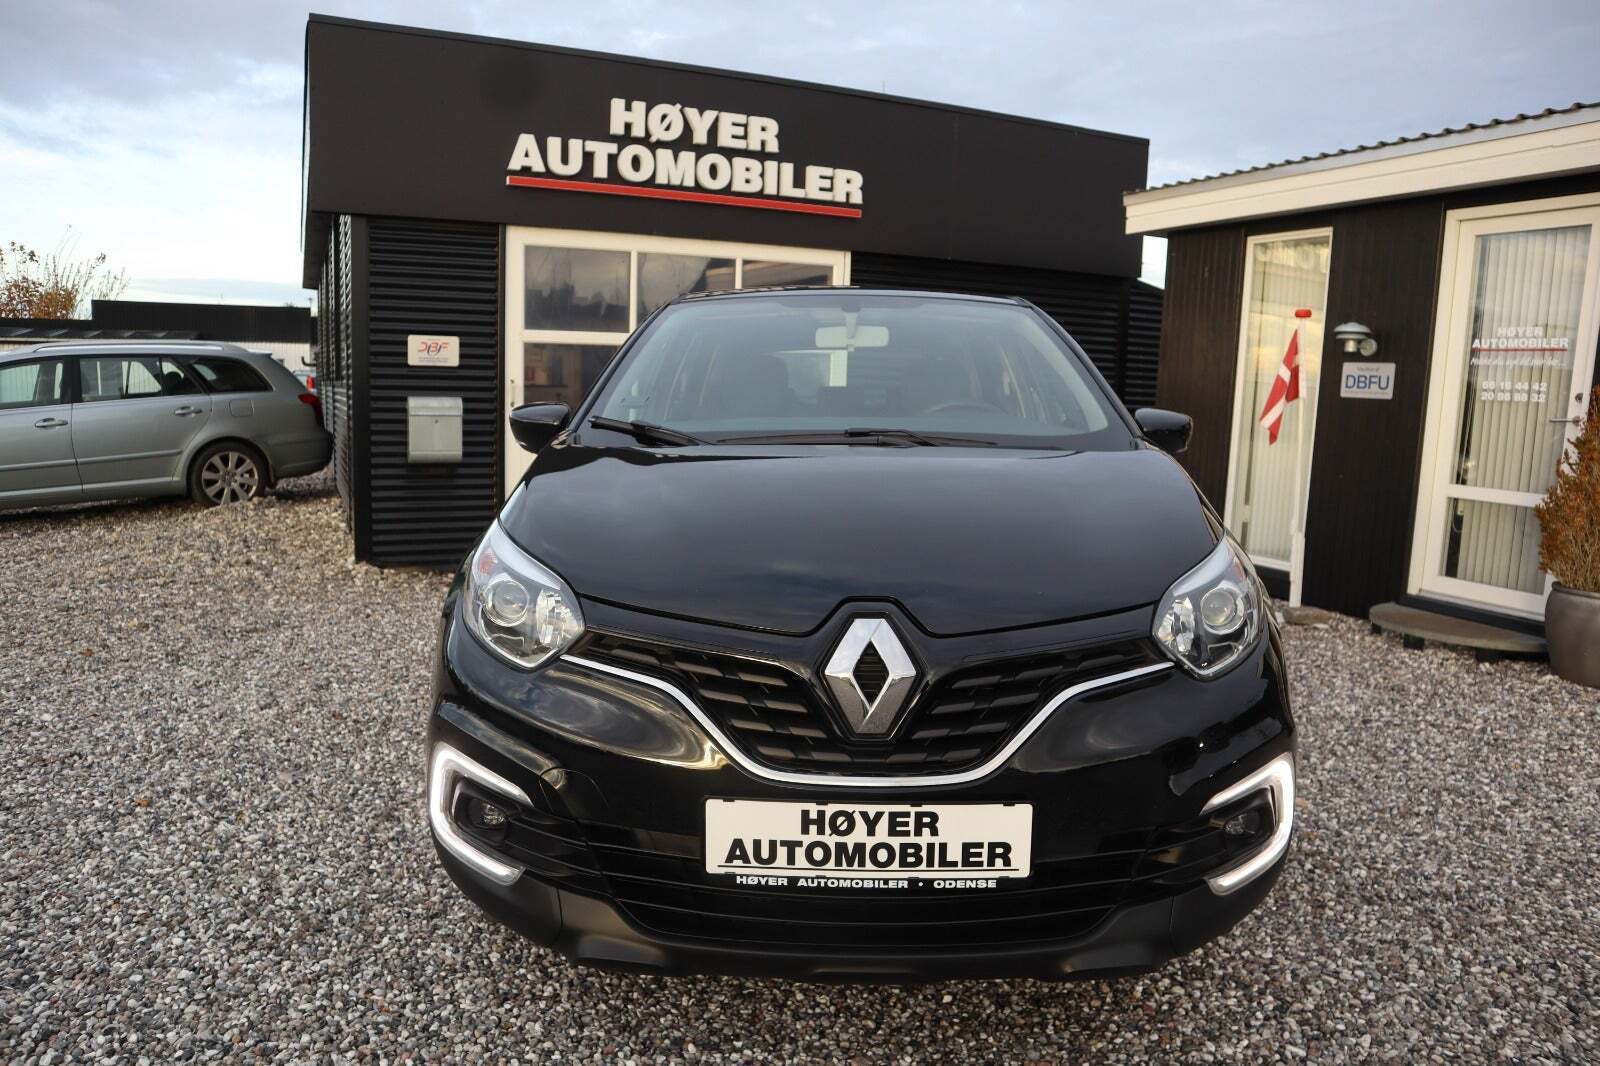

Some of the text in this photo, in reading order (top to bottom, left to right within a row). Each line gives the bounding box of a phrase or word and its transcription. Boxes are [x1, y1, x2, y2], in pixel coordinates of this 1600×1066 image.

[609, 97, 780, 153] HØYER
[506, 133, 864, 204] AUTOMOBILER
[1472, 338, 1569, 348] AUTOMOBILER
[1345, 374, 1390, 390] DBFU
[800, 809, 940, 837] HØYER
[724, 838, 1012, 868] AUTOMOBILER
[736, 875, 997, 889] HØYER AUTOMOBILER ODENSE
